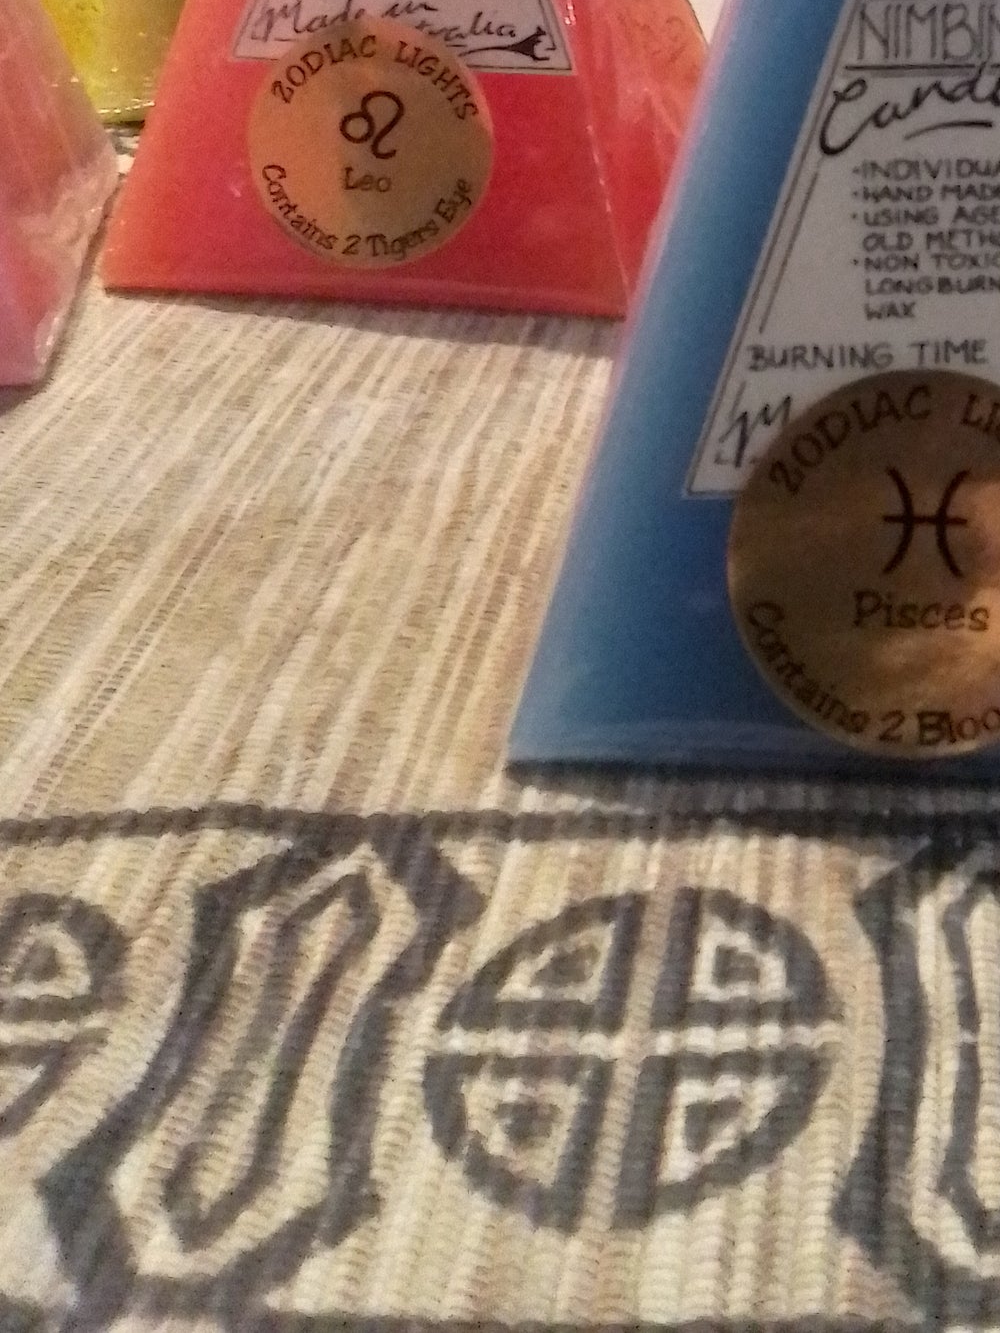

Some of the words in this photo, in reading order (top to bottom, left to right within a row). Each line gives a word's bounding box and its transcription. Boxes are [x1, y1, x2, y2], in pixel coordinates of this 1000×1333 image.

[271, 34, 377, 104] ZODIAC
[394, 40, 479, 121] LIGHTS
[343, 166, 392, 193] Leo
[862, 183, 934, 203] HAND
[261, 164, 339, 251] Contains
[341, 234, 362, 256] 2
[365, 219, 441, 261] Tigers
[434, 178, 473, 224] Eye
[862, 205, 939, 227] USING
[862, 230, 914, 252] OLD
[864, 253, 920, 272] NON
[864, 300, 916, 322] WAX
[747, 341, 895, 372] BURNING
[906, 337, 990, 367] TIME
[768, 384, 932, 496] ZODIAC
[853, 588, 990, 633] Pisces
[746, 599, 872, 735] Contains
[878, 709, 906, 744] 2
